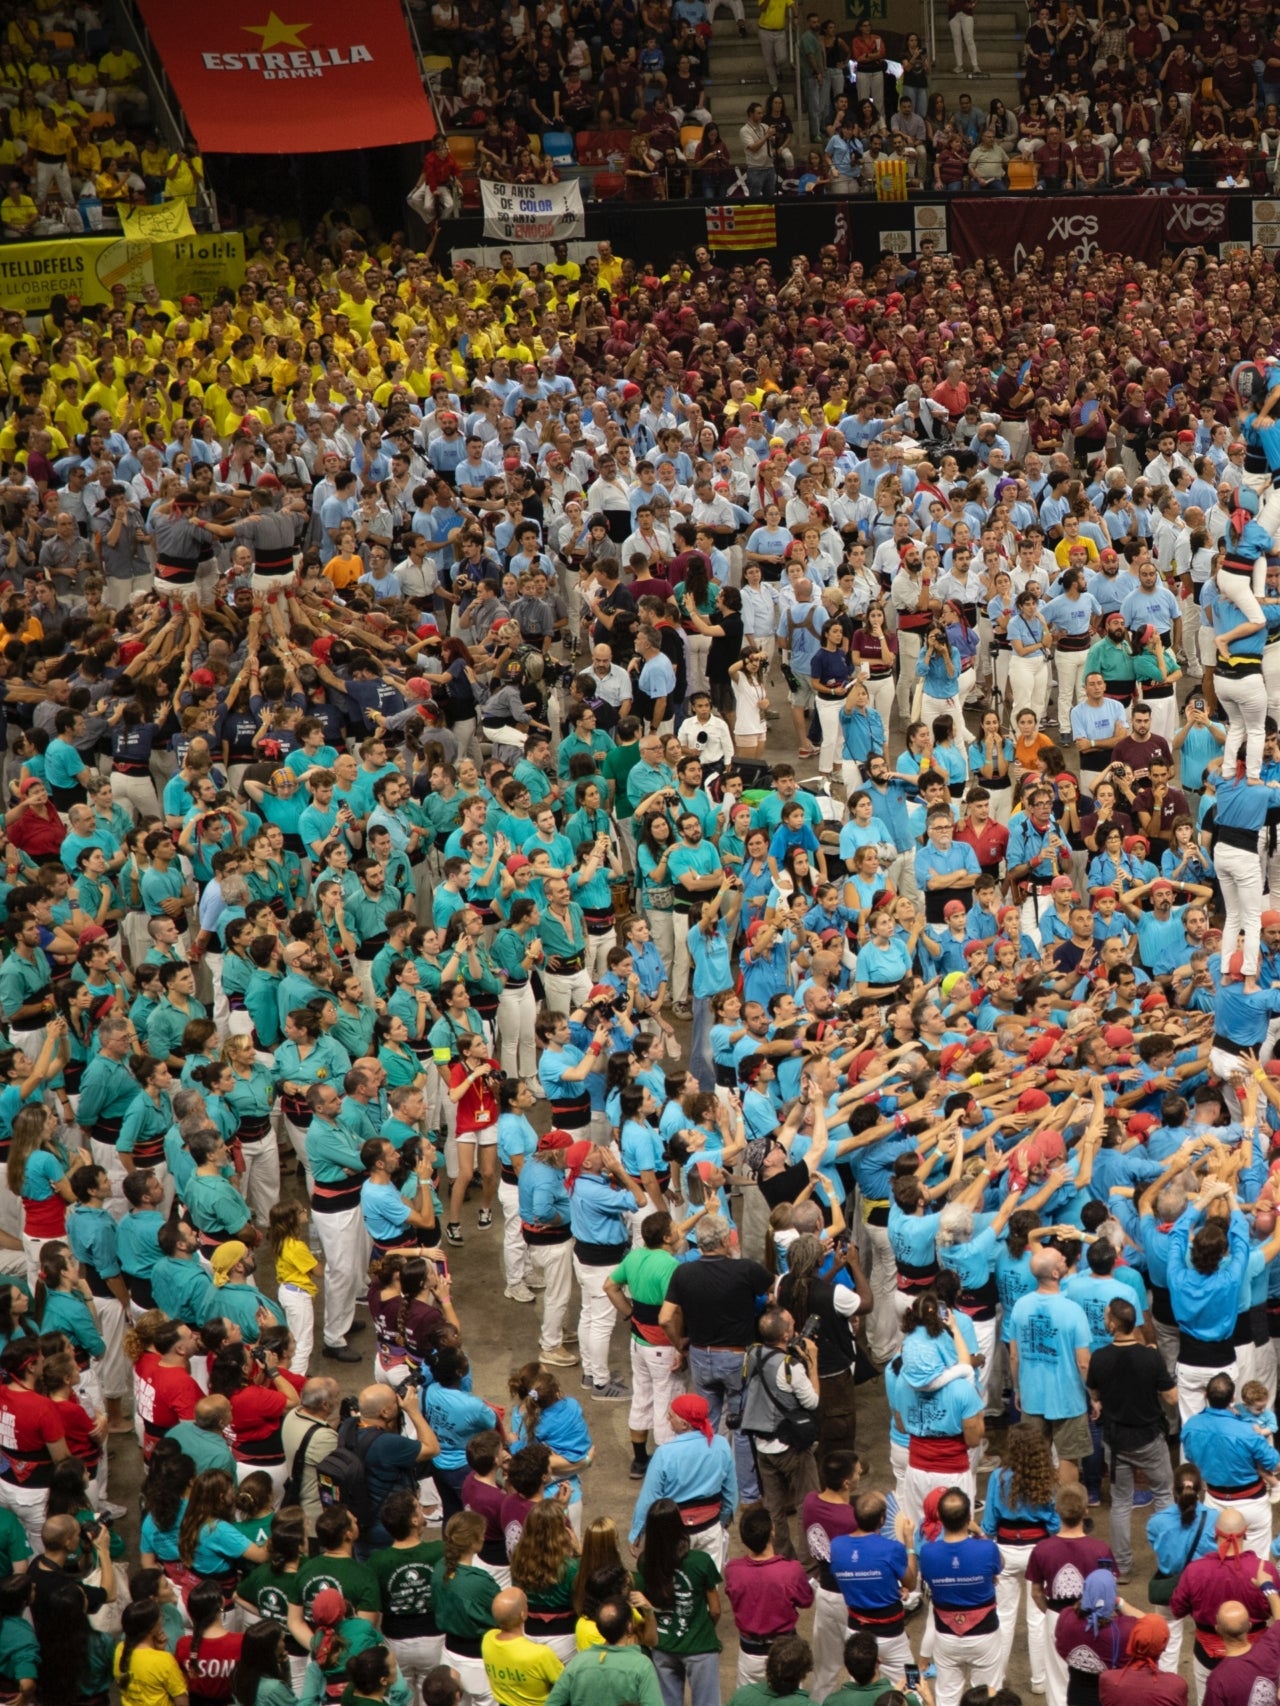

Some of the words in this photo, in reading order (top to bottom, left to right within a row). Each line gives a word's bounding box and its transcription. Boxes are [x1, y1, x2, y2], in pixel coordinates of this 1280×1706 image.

[201, 45, 374, 70] ESTRELLA
[263, 68, 323, 79] DAMM
[493, 184, 506, 196] 50
[511, 186, 535, 199] ANYS
[501, 198, 513, 210] DE
[520, 200, 552, 212] COLOR
[498, 212, 509, 221] 50
[1167, 203, 1225, 231] XICS
[1047, 215, 1099, 240] XICS
[6, 277, 84, 296] LLOBREGAT
